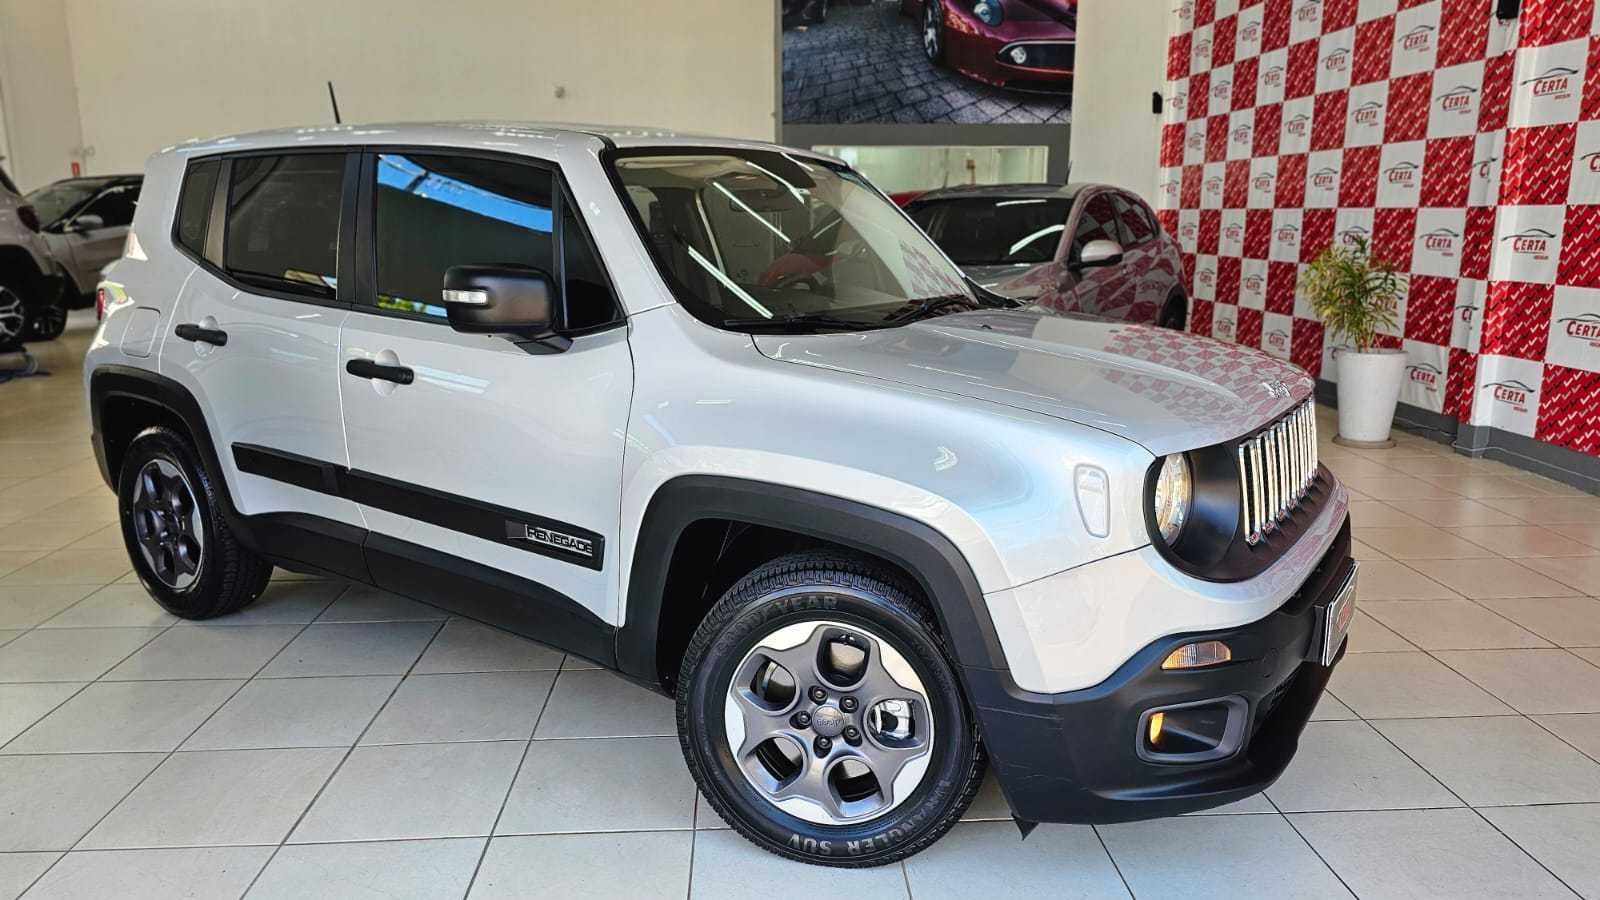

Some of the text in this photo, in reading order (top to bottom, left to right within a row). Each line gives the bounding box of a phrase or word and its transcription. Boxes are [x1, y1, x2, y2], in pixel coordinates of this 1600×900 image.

[1533, 78, 1568, 95] CERTA
[1442, 95, 1469, 110] CERTA
[1426, 236, 1451, 248] CERTA
[1513, 236, 1546, 251] CERTA
[1494, 385, 1525, 403] CERTA
[526, 526, 592, 554] RENEGADE
[788, 833, 832, 855] SUV
